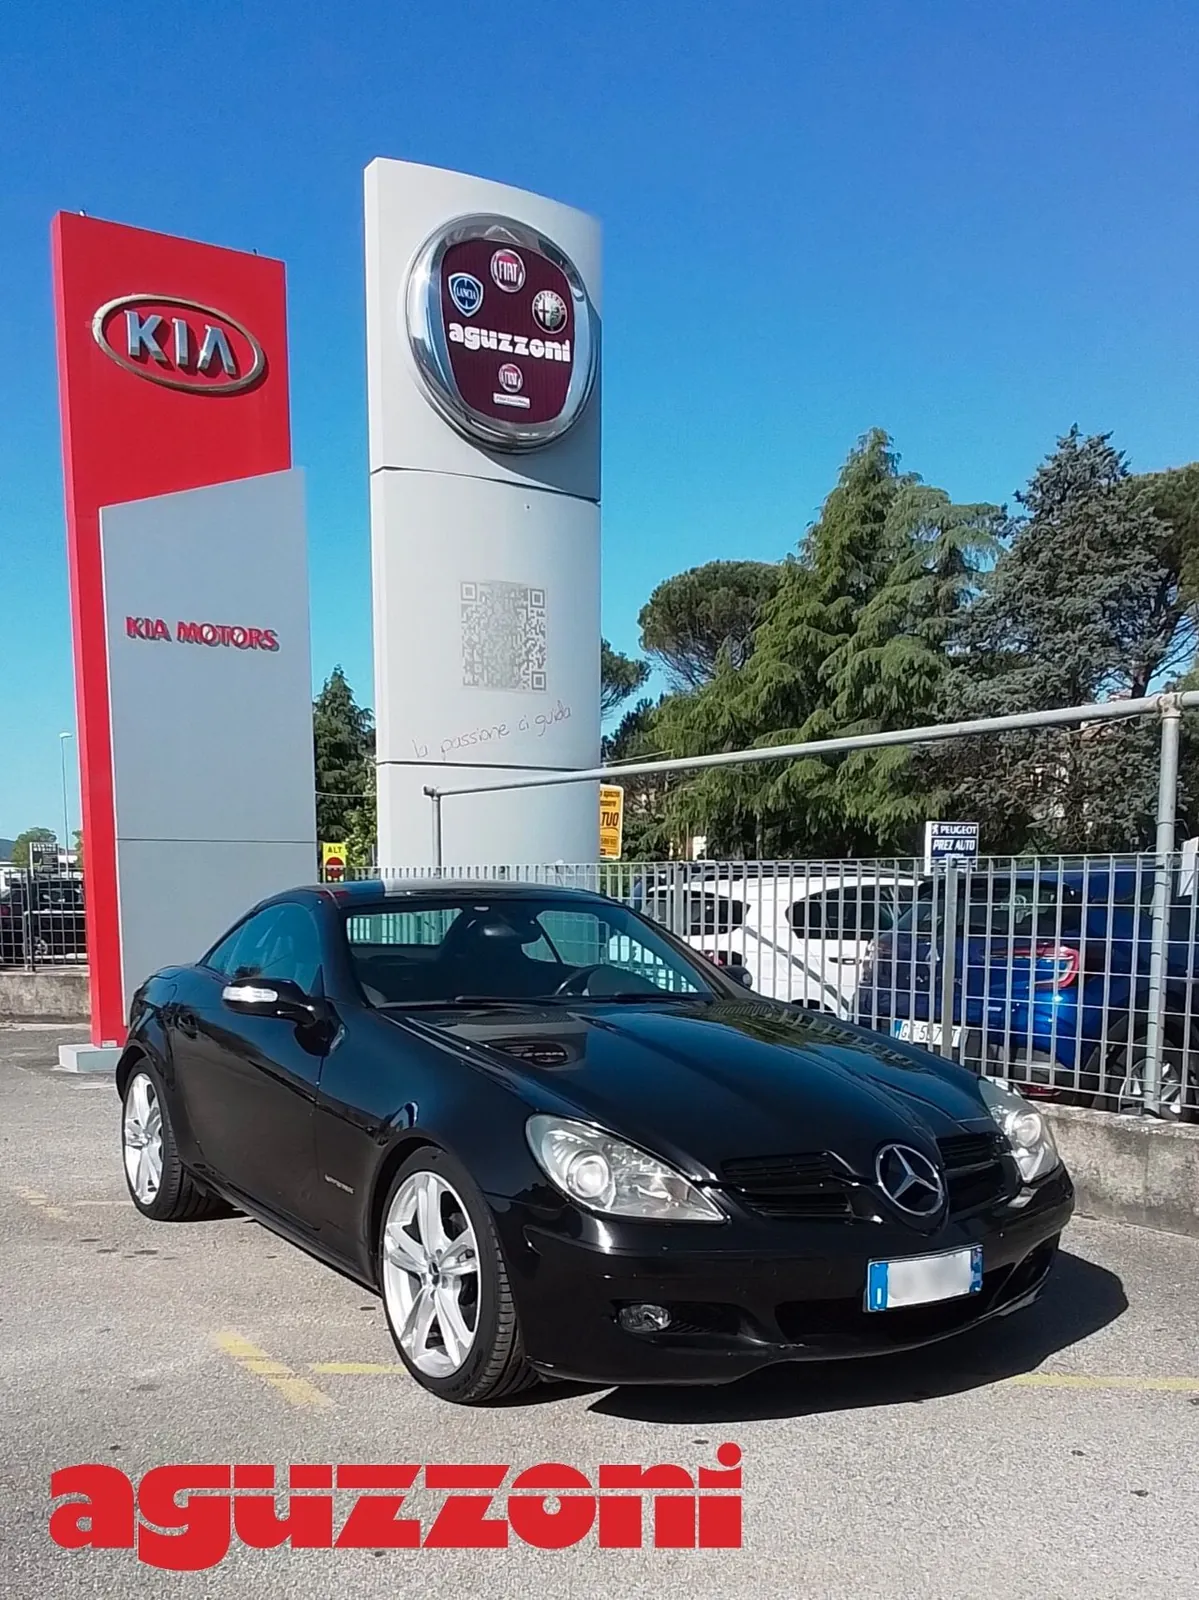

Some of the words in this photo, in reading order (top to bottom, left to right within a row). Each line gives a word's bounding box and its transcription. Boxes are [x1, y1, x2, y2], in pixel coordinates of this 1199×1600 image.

[498, 260, 518, 283] FIAT
[456, 286, 477, 300] LANCIA
[124, 310, 236, 375] KIA
[448, 322, 571, 362] aguzzoni
[125, 616, 172, 642] KIA
[176, 621, 280, 652] MOTORS
[440, 723, 511, 761] passione
[518, 714, 530, 732] ci
[535, 699, 572, 738] guida
[602, 812, 619, 827] TUO
[940, 825, 977, 834] PEUGEOT
[932, 839, 954, 851] PREZ
[954, 839, 976, 851] AUTO
